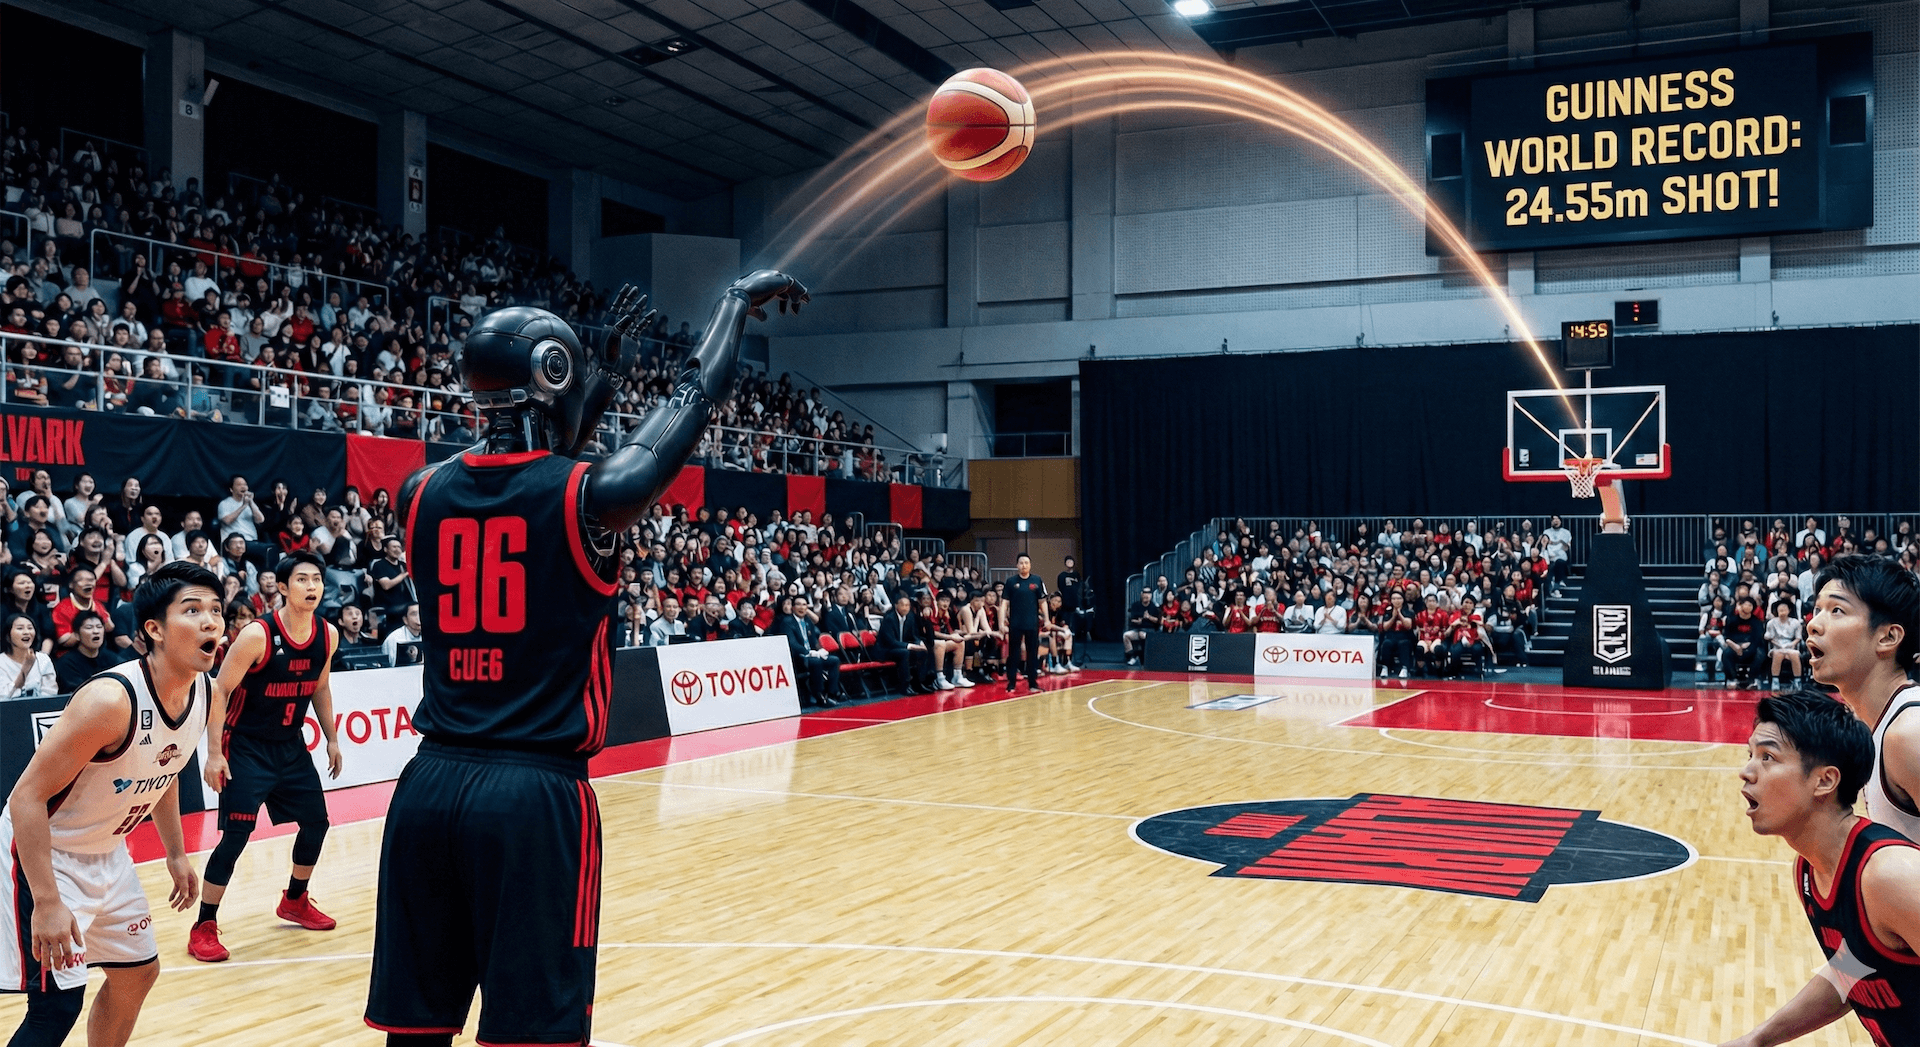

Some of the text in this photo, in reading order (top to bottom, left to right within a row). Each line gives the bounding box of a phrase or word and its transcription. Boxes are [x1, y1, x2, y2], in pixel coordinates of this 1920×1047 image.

[1546, 67, 1735, 123] GUINNESS
[1484, 115, 1801, 178] WORLD RECORD:
[1505, 168, 1779, 226] 24.55m SHOT!
[1570, 323, 1609, 339] 14:55
[438, 516, 527, 633] 96
[450, 648, 504, 682] CUE6
[1293, 648, 1364, 664] TOYOTA
[705, 664, 789, 697] TOYOTA
[282, 703, 297, 726] 9
